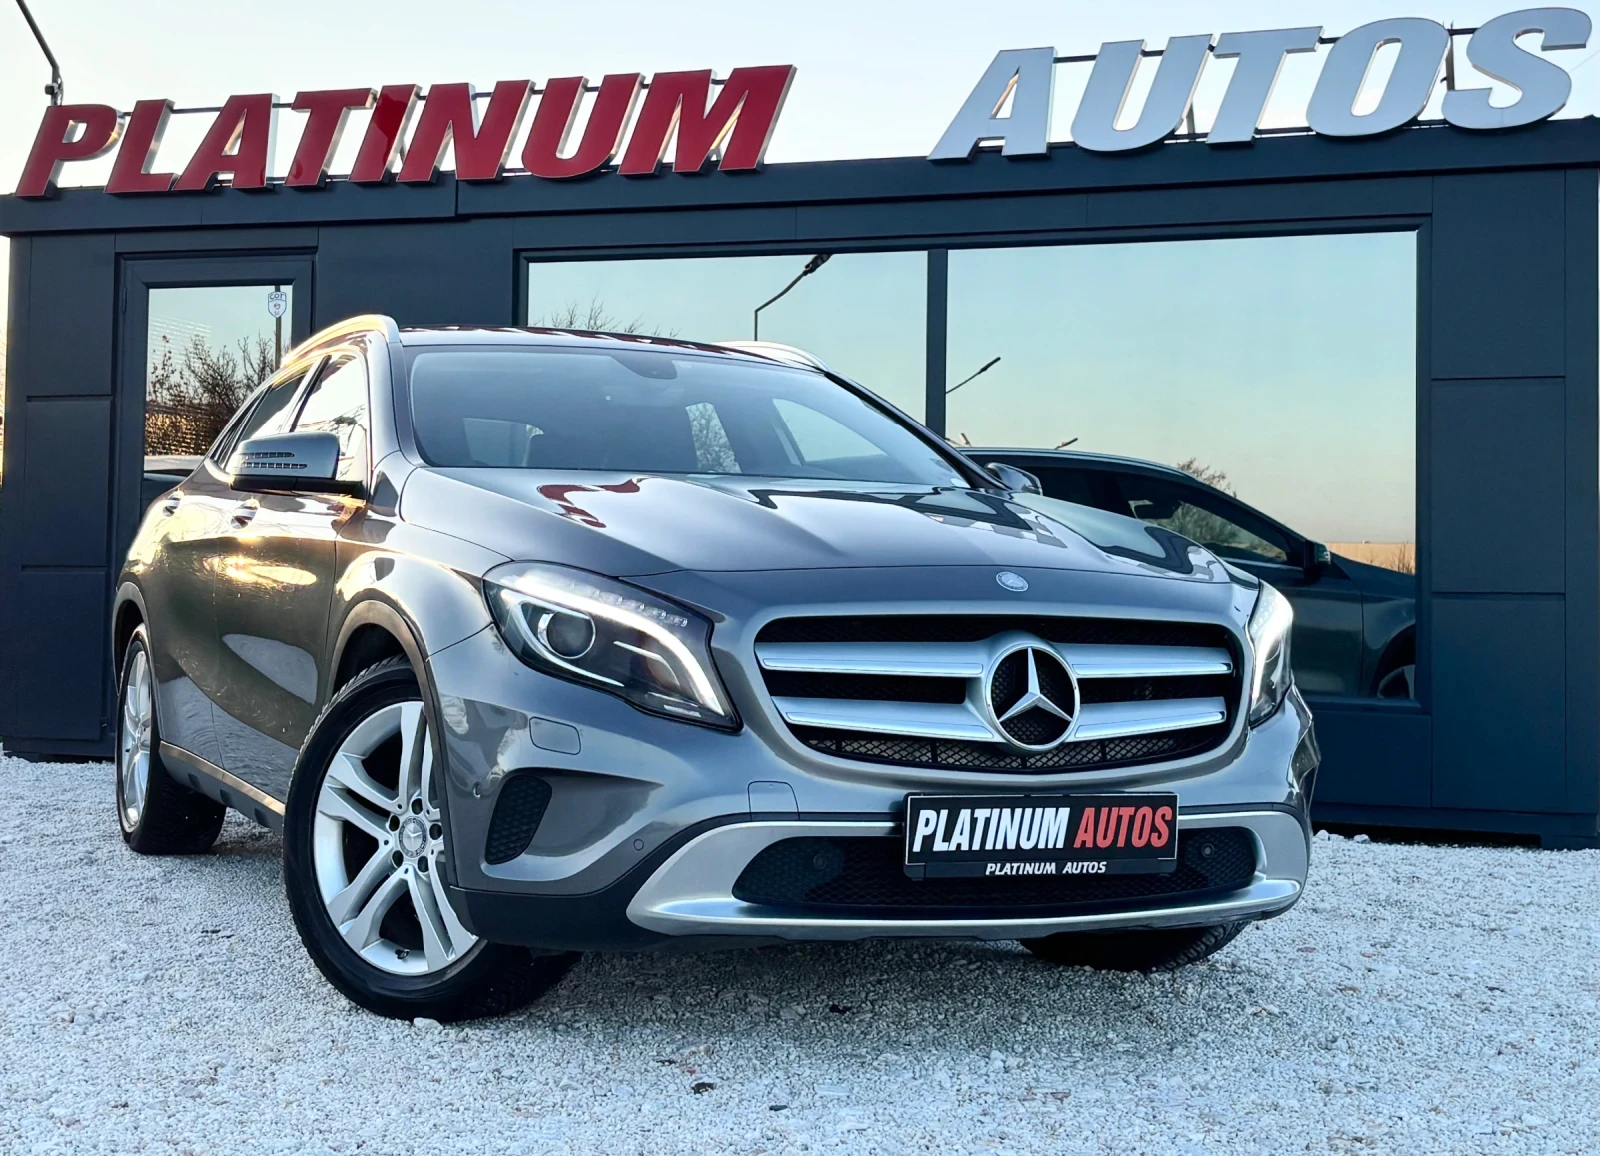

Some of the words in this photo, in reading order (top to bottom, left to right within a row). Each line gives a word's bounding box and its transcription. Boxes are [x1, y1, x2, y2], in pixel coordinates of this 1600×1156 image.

[15, 64, 796, 199] PLATINUM
[928, 7, 1592, 161] AUTOS
[912, 807, 1070, 852] PLATINUM
[1073, 806, 1172, 848] AUTOS
[985, 862, 1056, 876] PLATINUM
[1062, 861, 1107, 874] AUTOS
